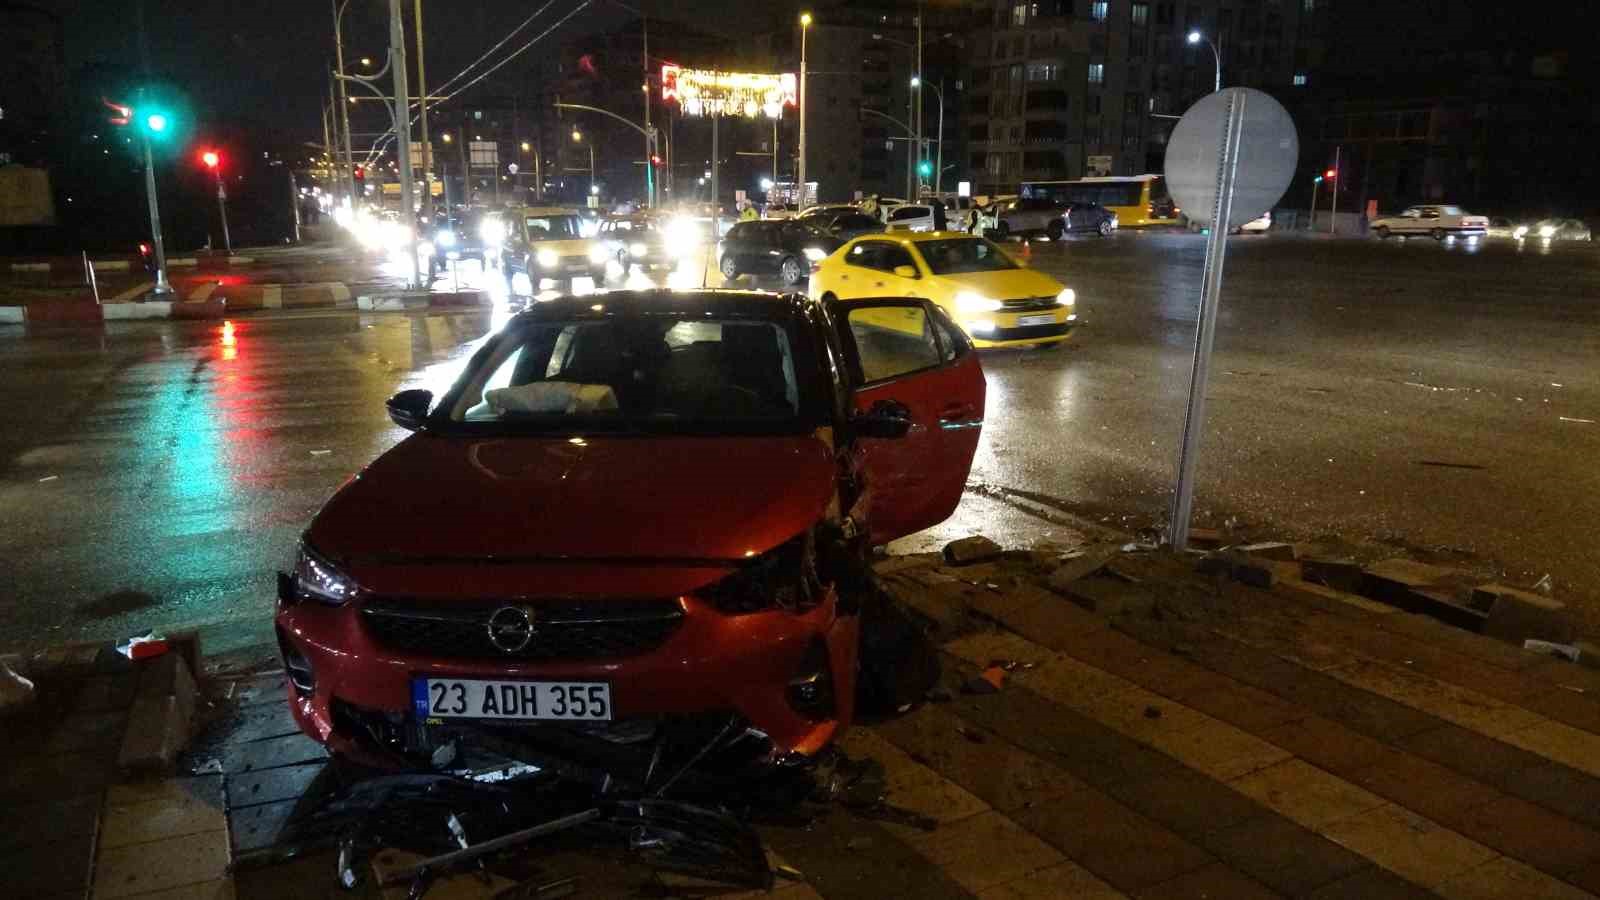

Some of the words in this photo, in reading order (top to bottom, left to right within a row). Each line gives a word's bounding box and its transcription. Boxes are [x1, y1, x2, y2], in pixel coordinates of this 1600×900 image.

[416, 700, 428, 710] TR
[431, 683, 467, 714] 23
[482, 685, 538, 716] ADH
[550, 686, 607, 717] 355
